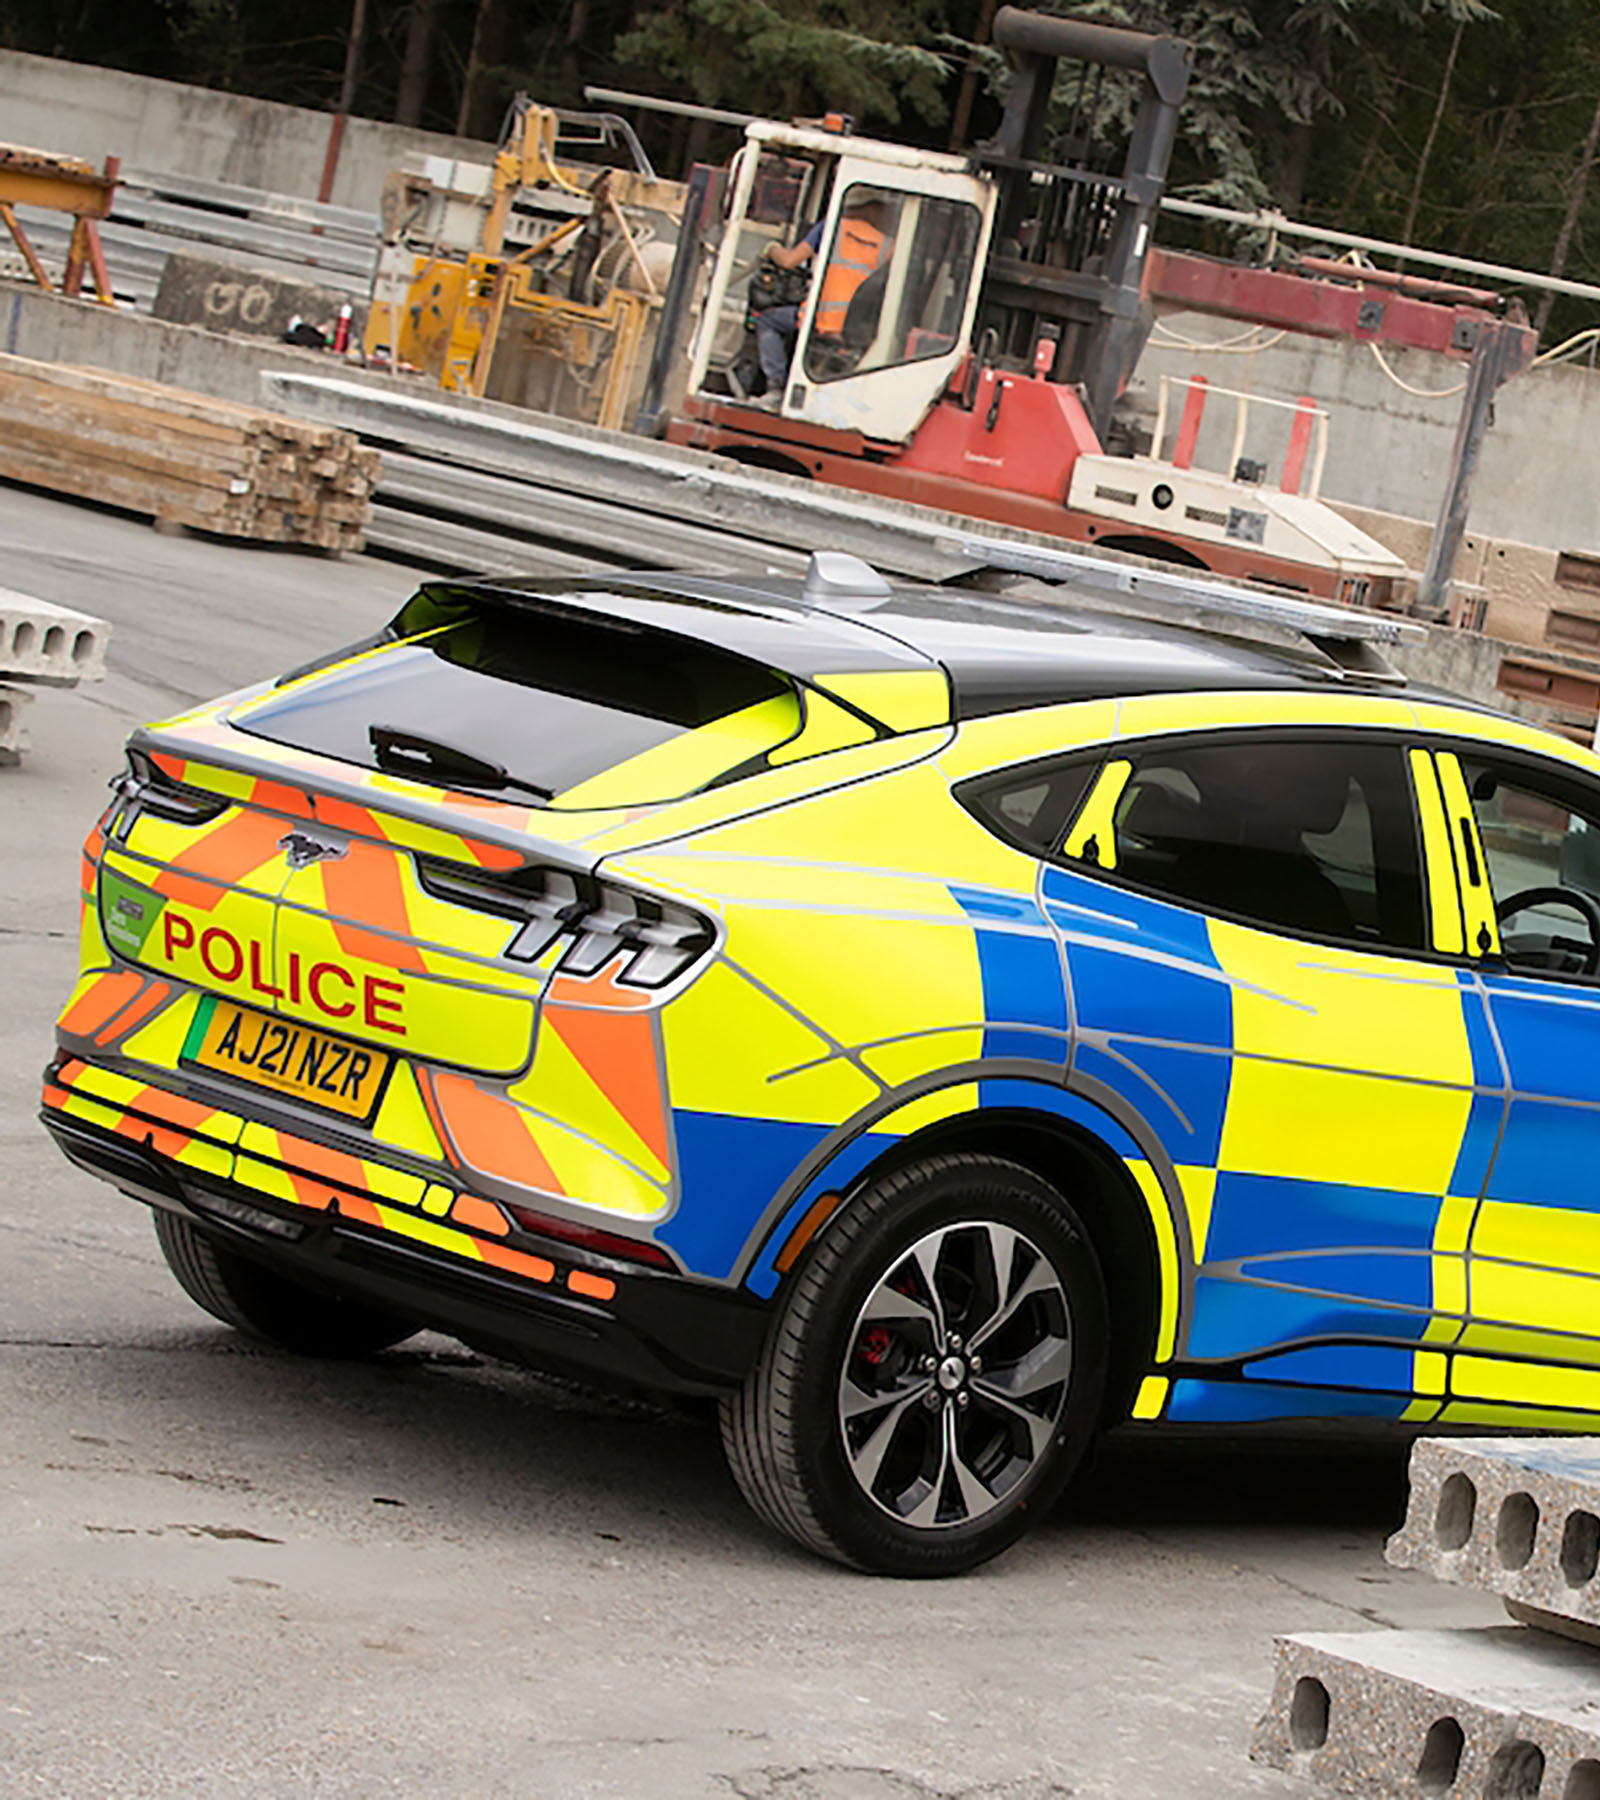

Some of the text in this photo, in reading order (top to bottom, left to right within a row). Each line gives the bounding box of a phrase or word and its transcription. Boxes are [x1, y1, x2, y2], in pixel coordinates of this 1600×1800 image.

[164, 911, 406, 1036] POLICE
[215, 1011, 372, 1101] AJ21 NZR
